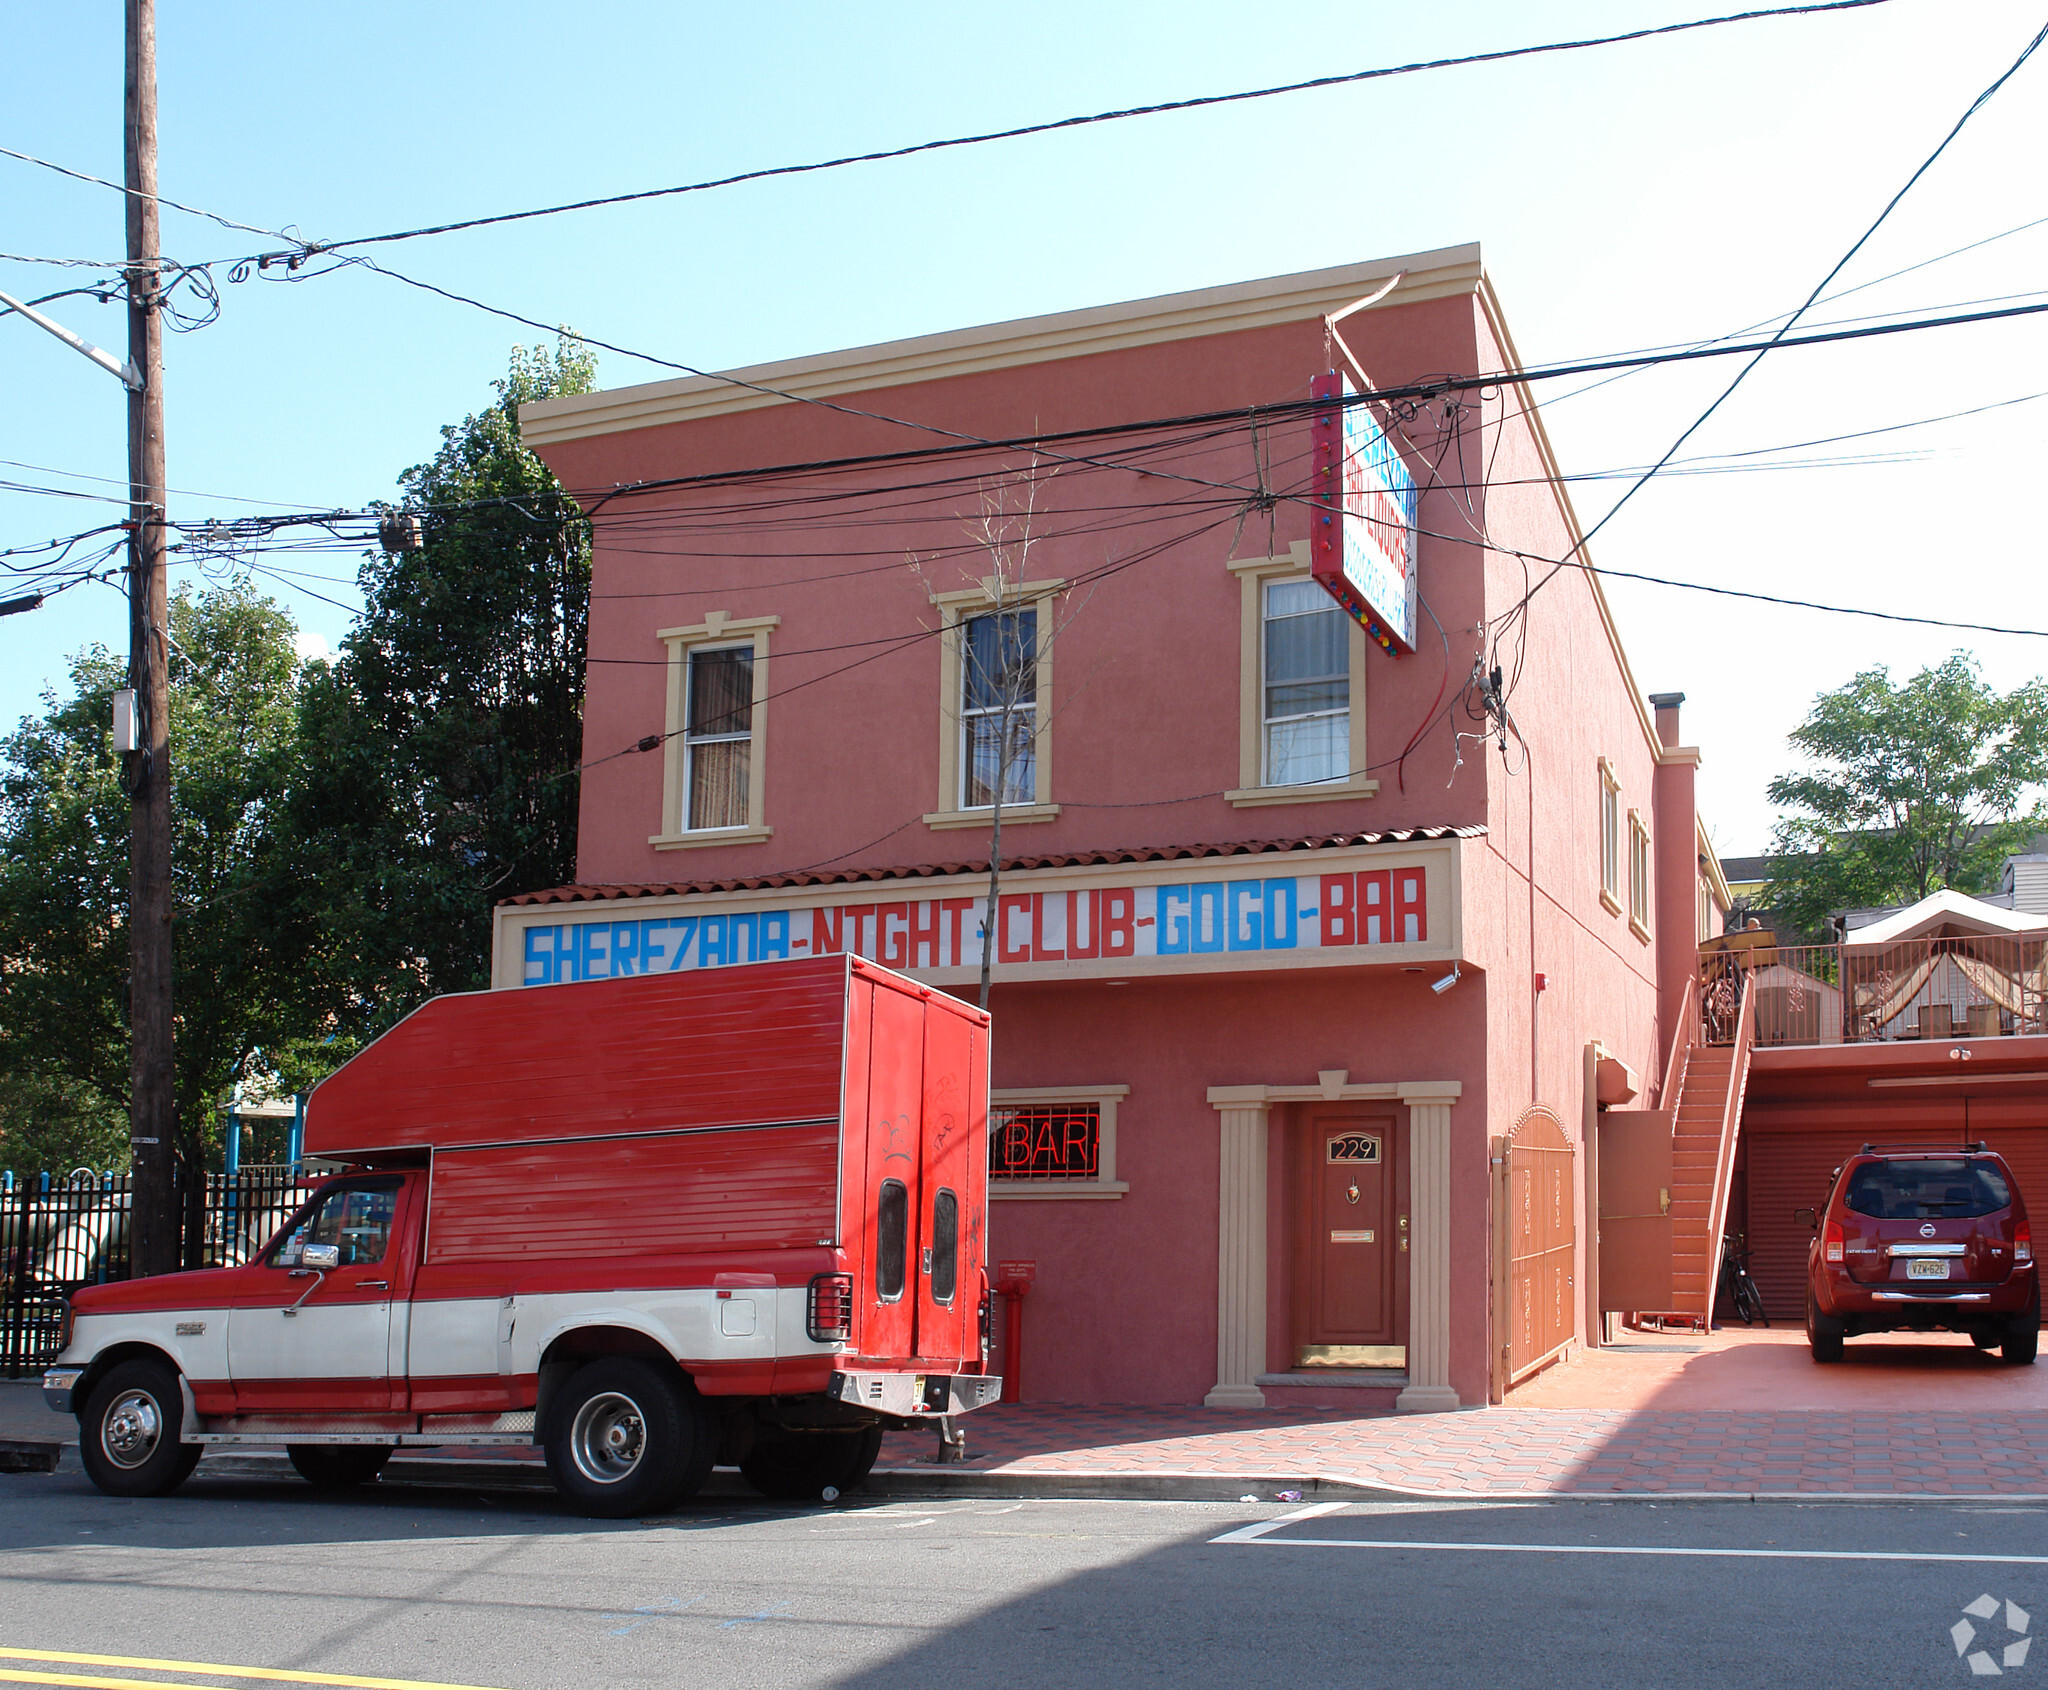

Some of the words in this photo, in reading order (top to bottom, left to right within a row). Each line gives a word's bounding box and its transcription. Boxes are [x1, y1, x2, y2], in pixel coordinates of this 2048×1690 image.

[1368, 476, 1406, 580] LIQUORS
[998, 887, 1135, 963] CLUB
[1157, 876, 1297, 955] GOGO
[1320, 866, 1428, 947] BAR
[1004, 1121, 1088, 1165] BAR
[1335, 1139, 1372, 1159] 229
